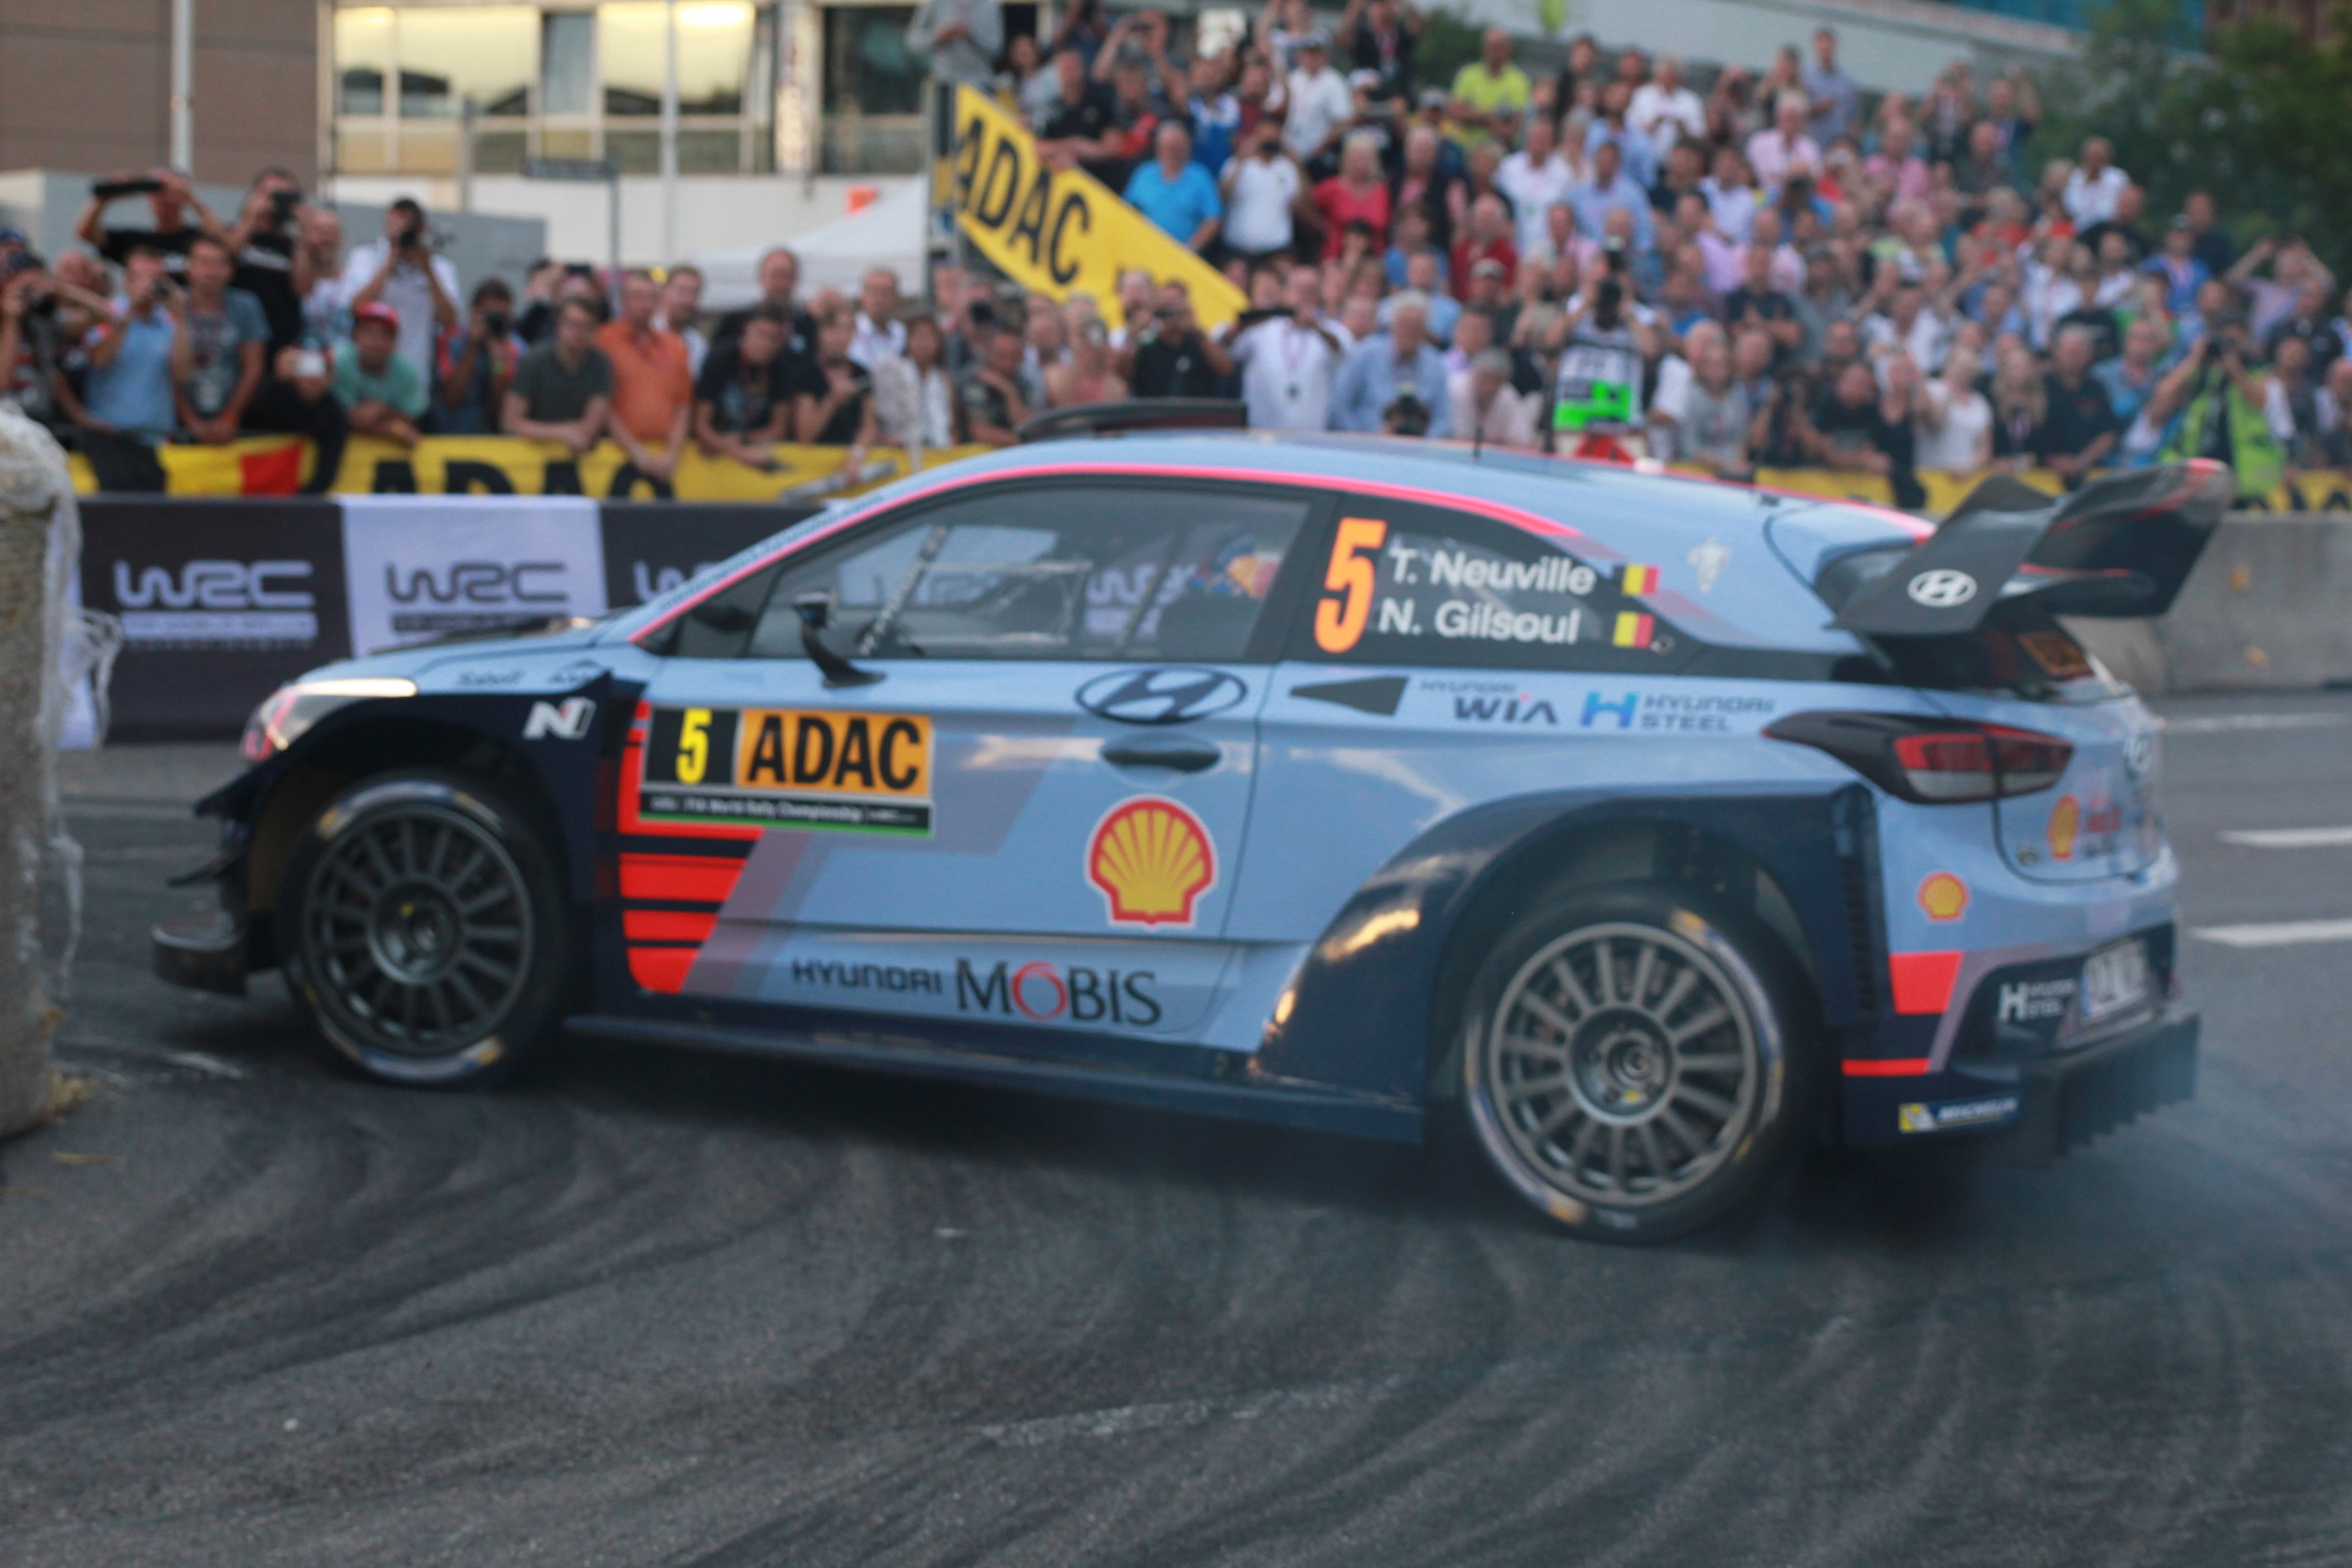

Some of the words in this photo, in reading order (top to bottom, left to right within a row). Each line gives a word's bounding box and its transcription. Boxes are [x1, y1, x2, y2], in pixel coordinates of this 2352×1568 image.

[956, 117, 1090, 285] ADAC
[114, 560, 315, 609] WRC
[384, 561, 568, 605] WRC
[1314, 517, 1387, 653] 5
[1389, 549, 1417, 585] T.
[1430, 550, 1596, 596] Neuville
[1378, 598, 1422, 635] N.
[1435, 600, 1581, 645] Gilsoul
[1642, 712, 1732, 732] STEEL
[1643, 693, 1776, 714] HYUNDAI
[675, 709, 712, 784] 5
[747, 714, 921, 790] ADAC
[791, 957, 943, 994] HYUNDAI
[956, 956, 1163, 1027] MOBIS
